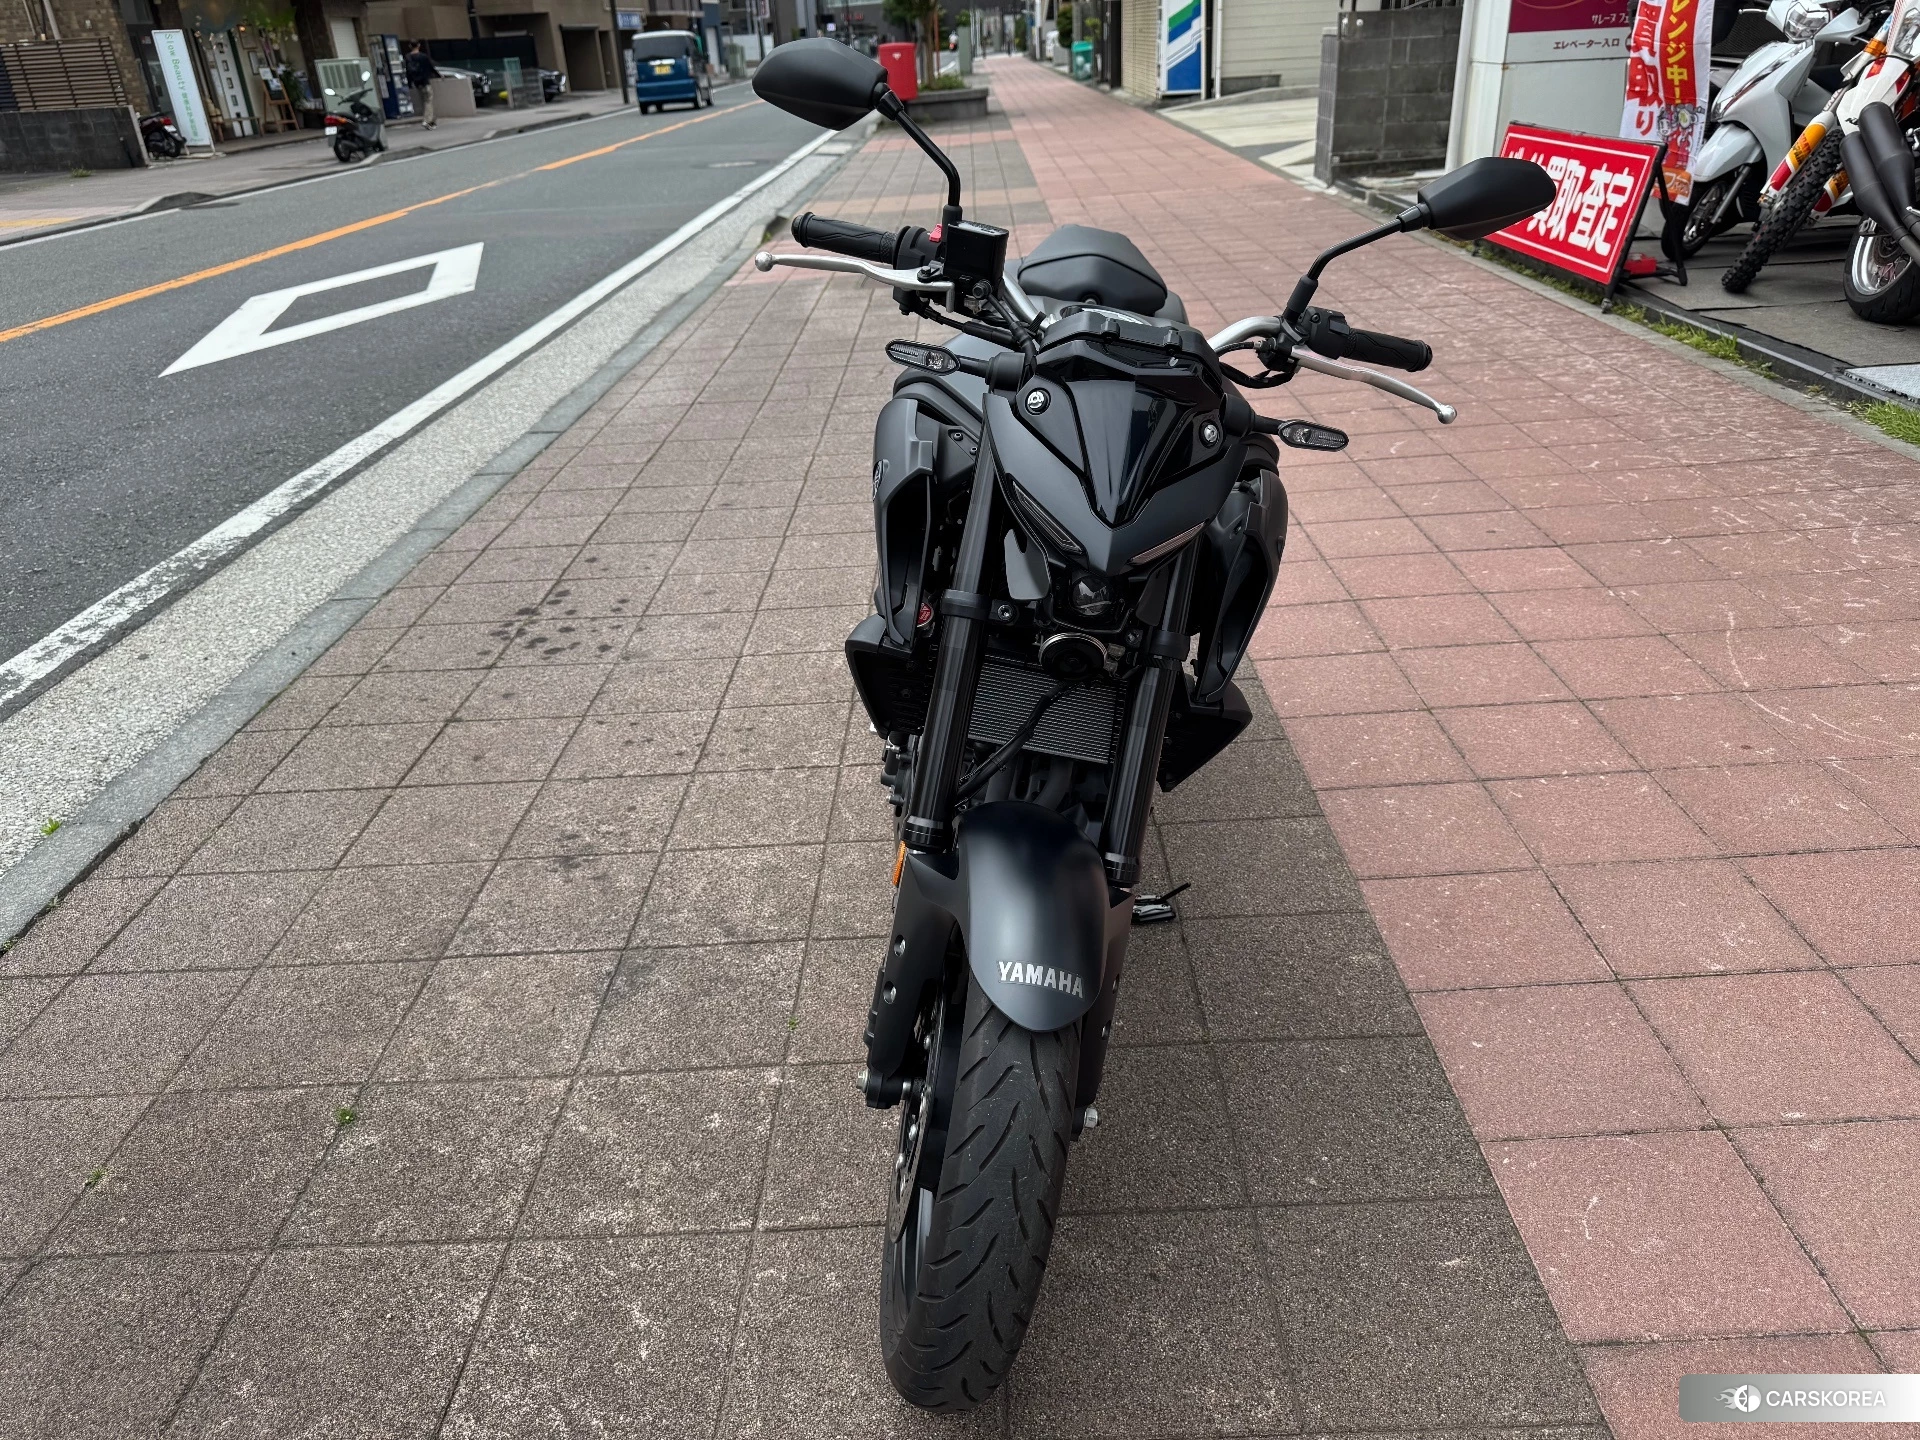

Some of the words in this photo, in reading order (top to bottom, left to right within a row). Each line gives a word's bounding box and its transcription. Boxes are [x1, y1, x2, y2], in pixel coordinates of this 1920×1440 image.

[164, 33, 177, 57] Slow
[172, 58, 187, 91] Beauty
[1552, 37, 1620, 50] エレベーター入口
[998, 960, 1084, 999] YAMAHA
